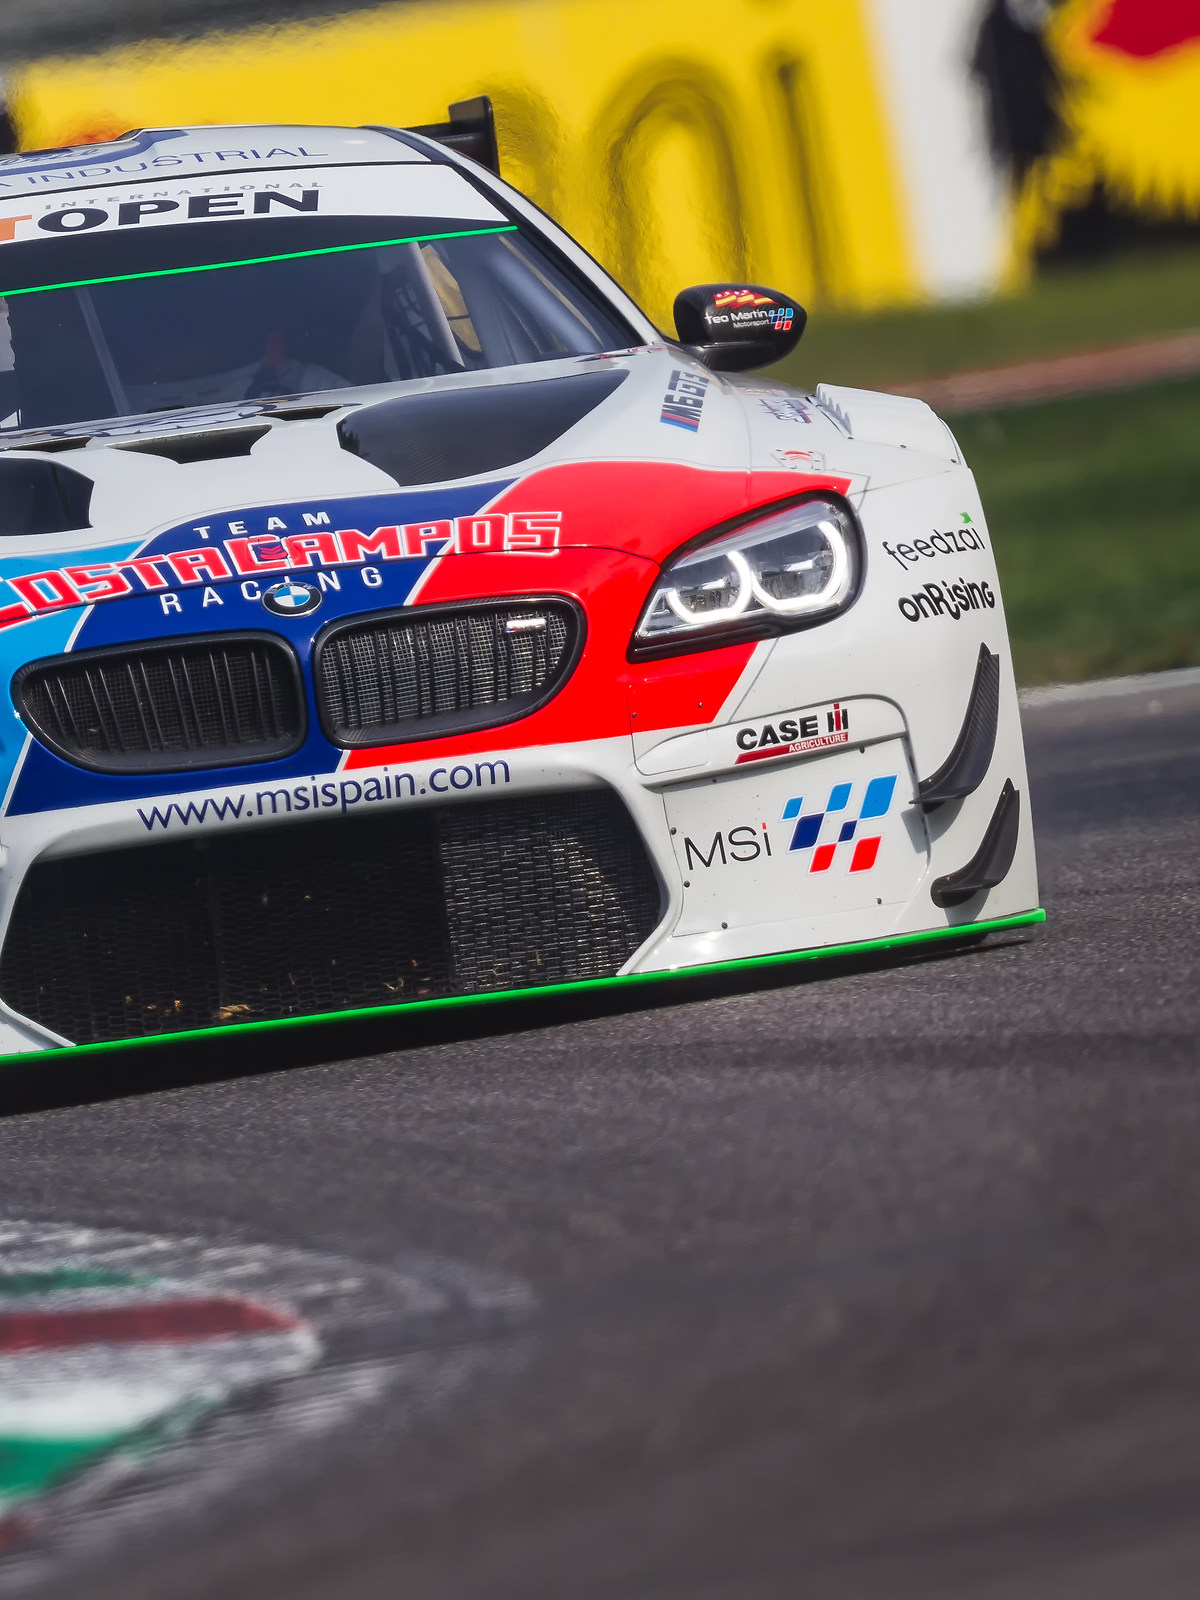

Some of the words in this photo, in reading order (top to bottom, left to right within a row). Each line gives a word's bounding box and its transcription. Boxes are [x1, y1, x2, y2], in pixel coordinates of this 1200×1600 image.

[27, 146, 328, 185] INDUSTRIAL
[45, 182, 324, 209] INTERNATIONAL
[193, 511, 331, 540] TEAM
[882, 527, 986, 571] feedzai
[897, 578, 995, 623] onRising
[736, 714, 819, 751] CASE
[788, 733, 847, 753] AGRICULTURE
[136, 758, 511, 831] www.msispain.com
[683, 822, 773, 871] MSi
